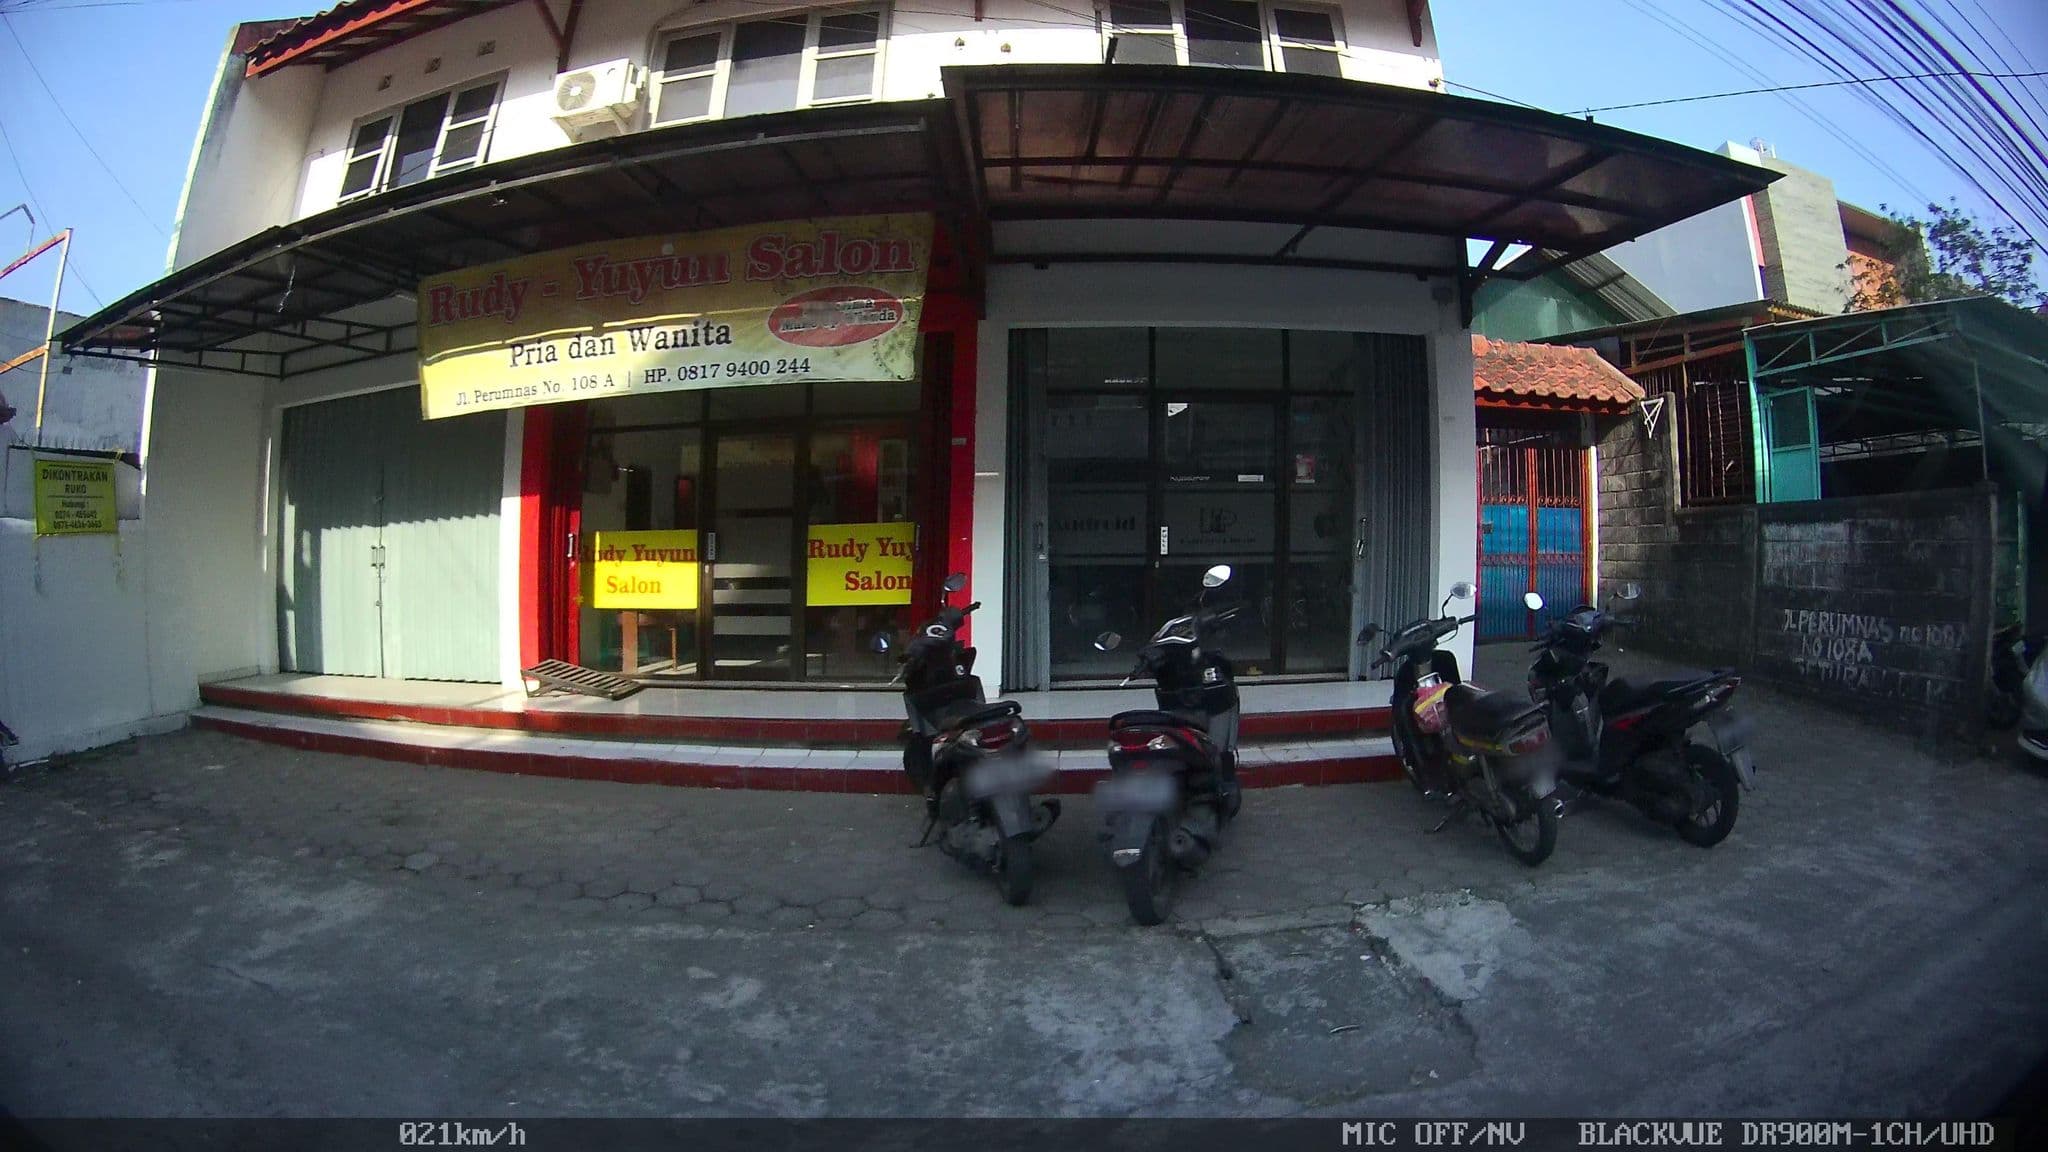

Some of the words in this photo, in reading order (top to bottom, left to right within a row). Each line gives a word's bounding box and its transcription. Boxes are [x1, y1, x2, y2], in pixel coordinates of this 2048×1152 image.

[429, 272, 528, 326] Rudy
[574, 254, 730, 305] Yuyun
[747, 230, 915, 280] Salon
[510, 337, 558, 367] Pria
[568, 333, 616, 359] dan
[627, 320, 732, 352] Wanita
[474, 384, 538, 404] Perumnas
[571, 374, 598, 391] 108
[603, 373, 615, 388] A
[644, 368, 671, 384] HP.
[677, 363, 720, 381] 0817
[726, 360, 770, 378] 9400
[776, 357, 811, 374] 244
[42, 468, 108, 482] DIKONTRAKAN
[65, 484, 87, 494] RUKO
[631, 544, 697, 567] Yuyun
[807, 538, 869, 562] Rudy
[606, 575, 661, 594] Salon
[845, 570, 913, 591] Salon
